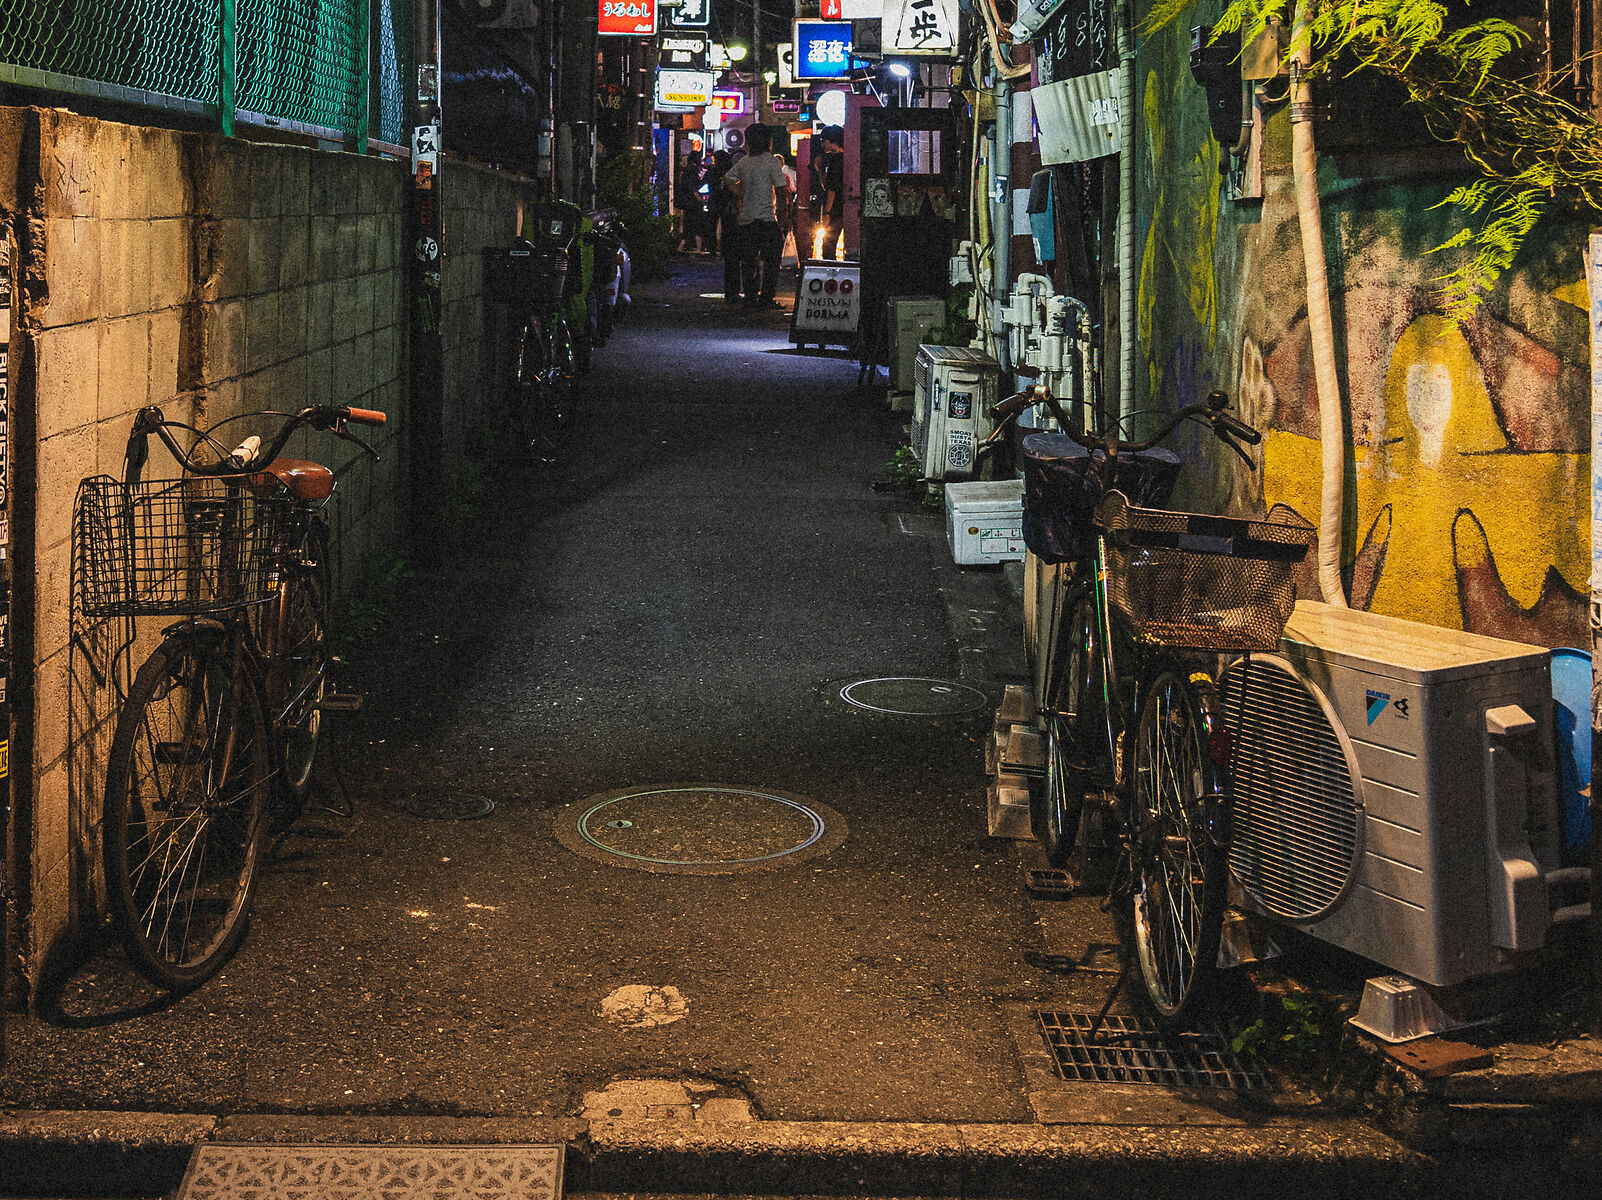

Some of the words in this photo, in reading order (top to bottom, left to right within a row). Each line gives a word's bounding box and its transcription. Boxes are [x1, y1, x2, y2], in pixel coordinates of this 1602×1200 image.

[603, 2, 651, 17] うるわし
[1366, 689, 1390, 700] DAIKIN
